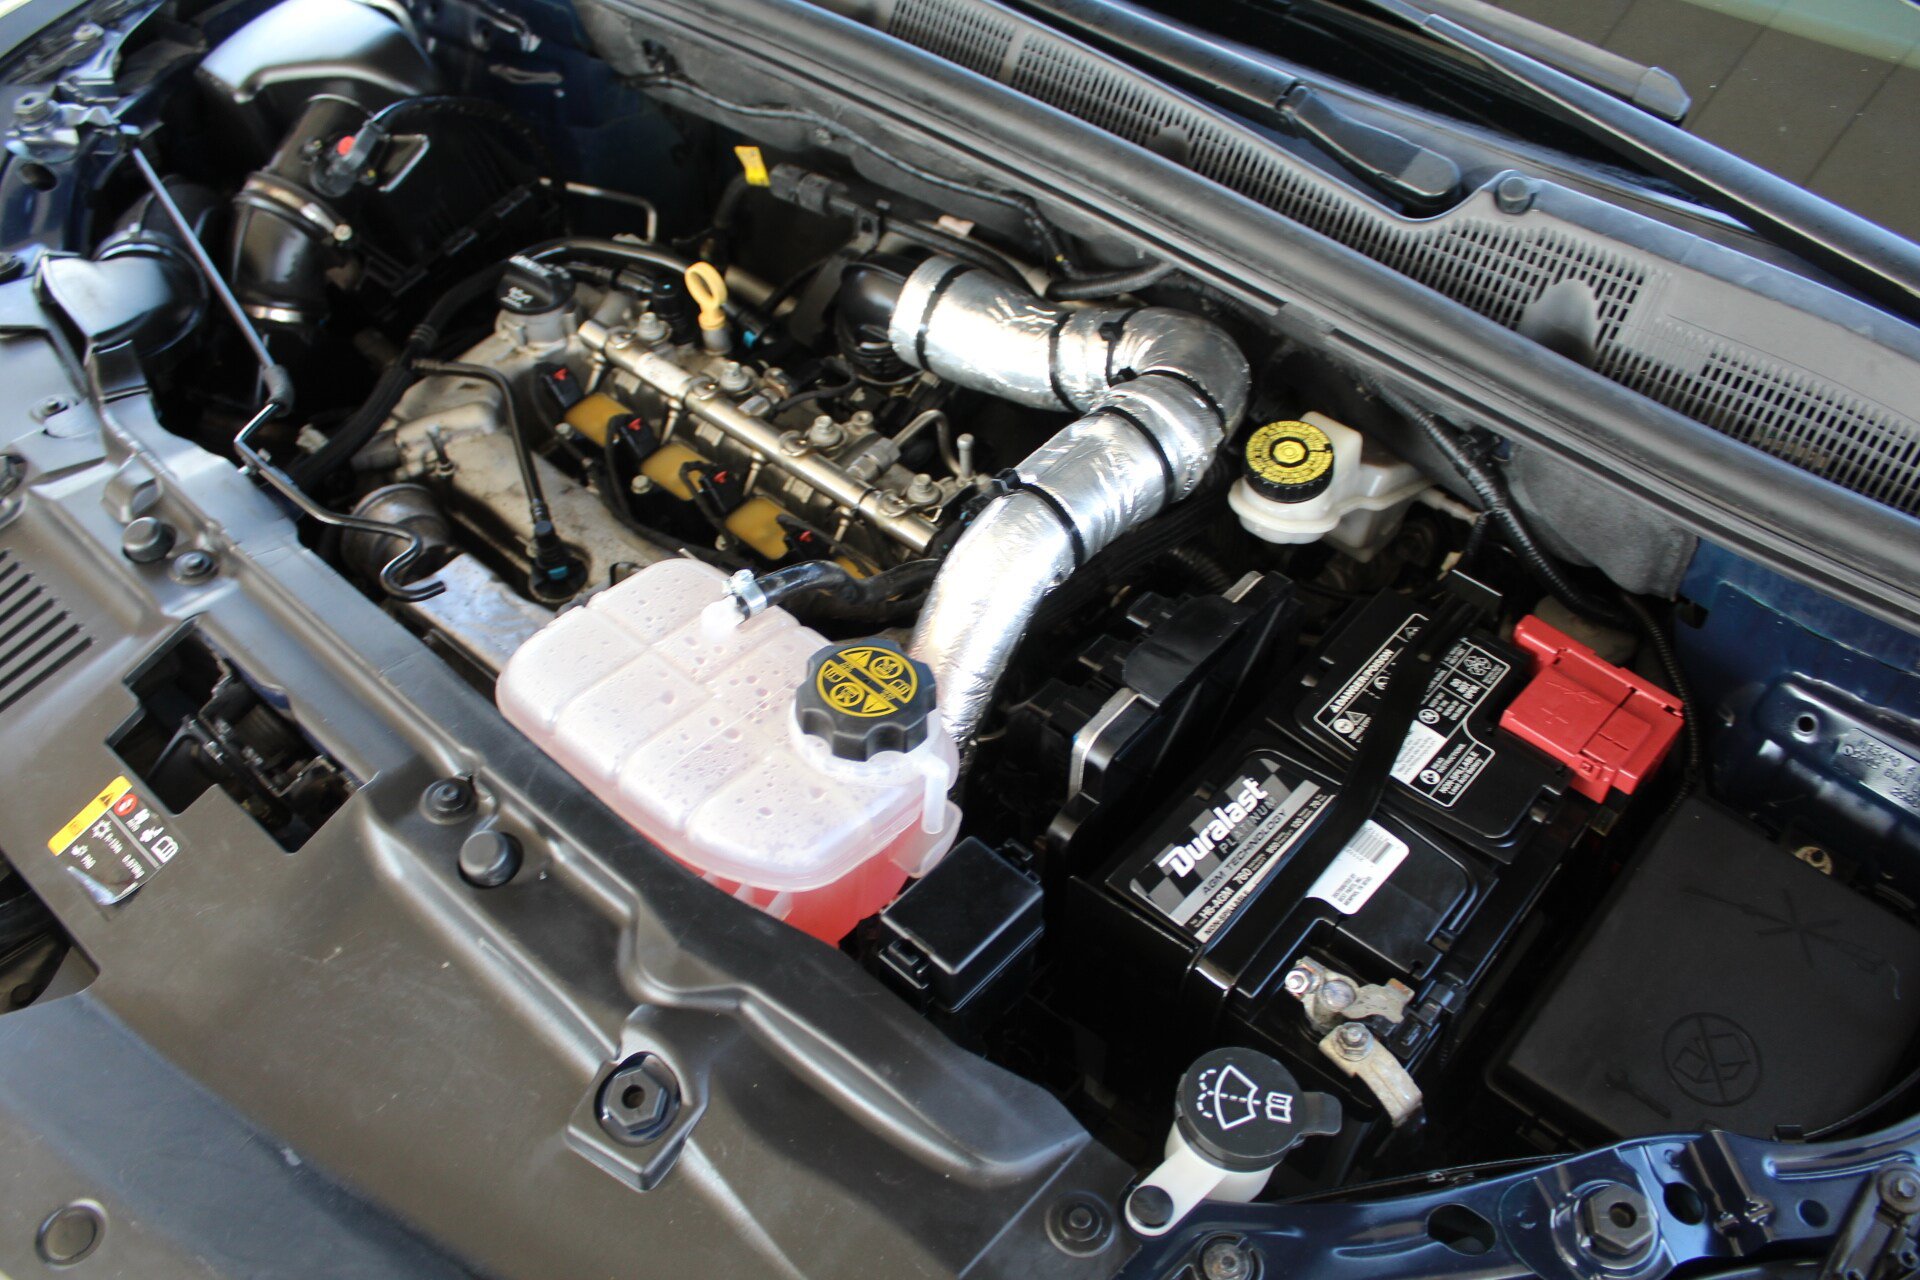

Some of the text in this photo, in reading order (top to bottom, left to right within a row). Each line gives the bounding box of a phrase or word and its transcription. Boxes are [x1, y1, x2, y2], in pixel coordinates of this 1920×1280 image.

[1157, 776, 1269, 878] Duralast
[1203, 870, 1226, 895] AGM
[1225, 808, 1287, 871] TECHNOLOGY
[1218, 797, 1277, 855] PLATINUM
